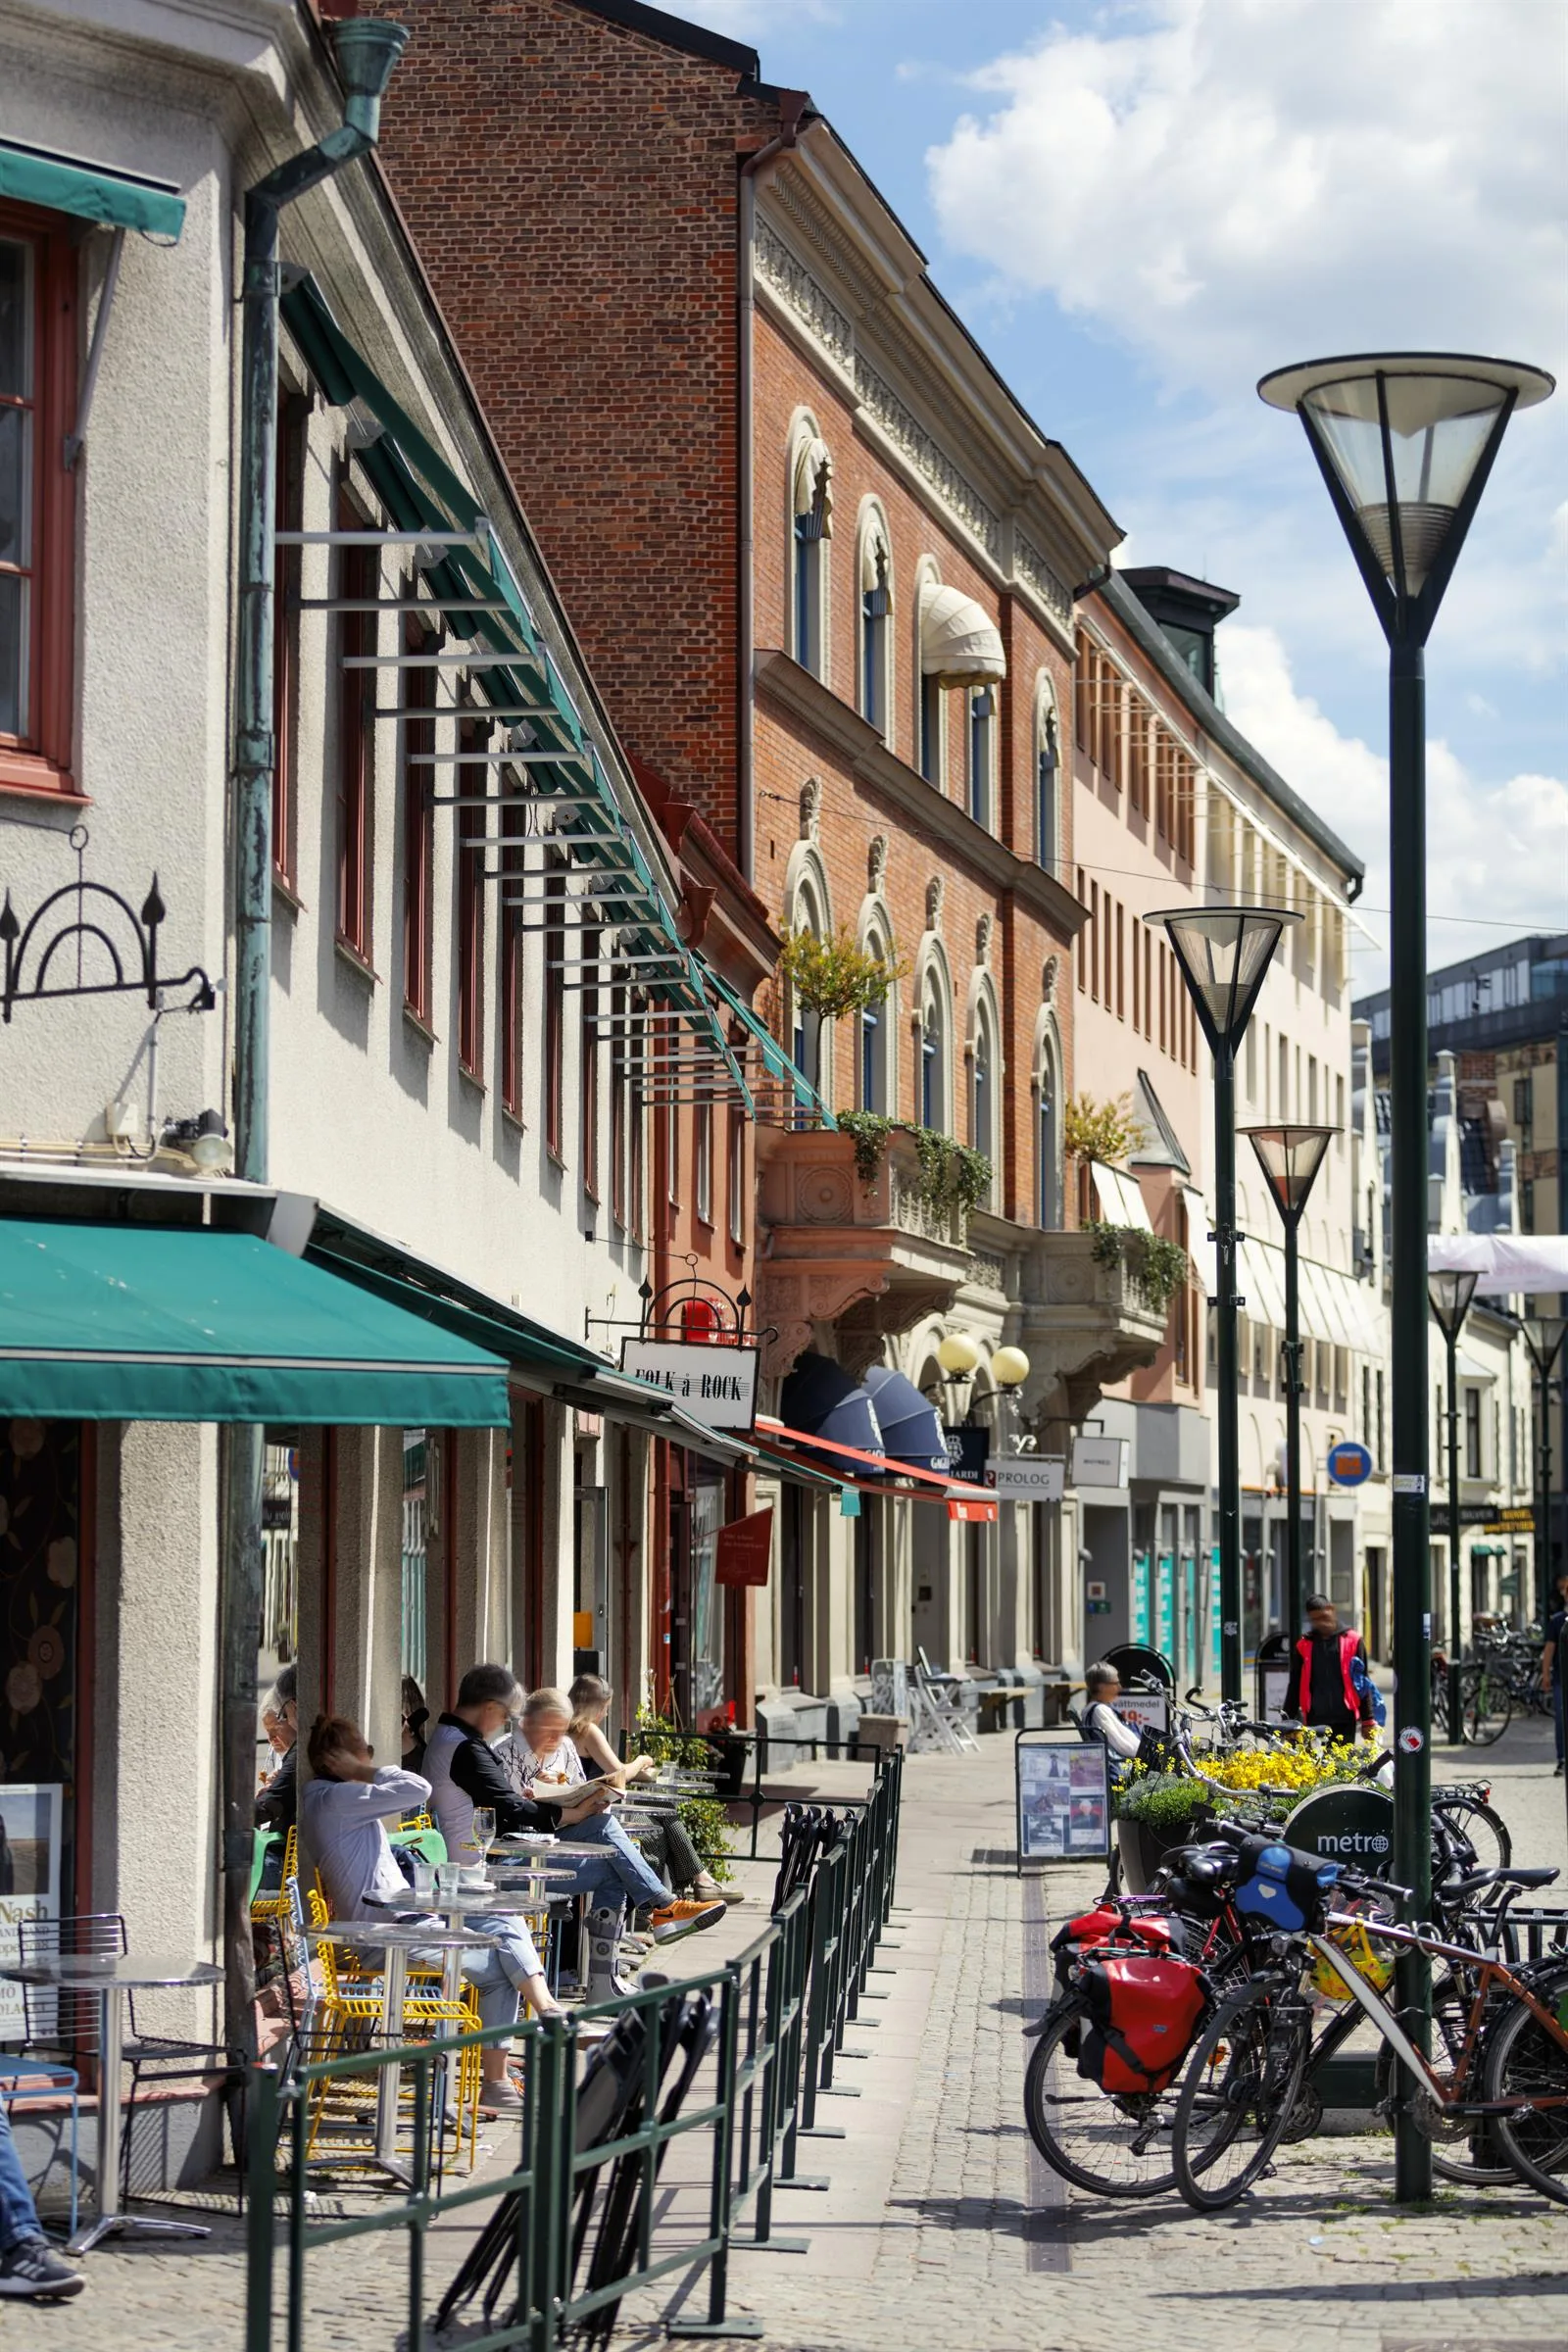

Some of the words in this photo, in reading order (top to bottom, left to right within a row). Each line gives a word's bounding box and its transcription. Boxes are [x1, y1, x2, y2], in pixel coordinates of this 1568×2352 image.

[701, 1374, 743, 1401] ROCK
[950, 1470, 979, 1480] IARDI
[998, 1472, 1050, 1486] PROLOG
